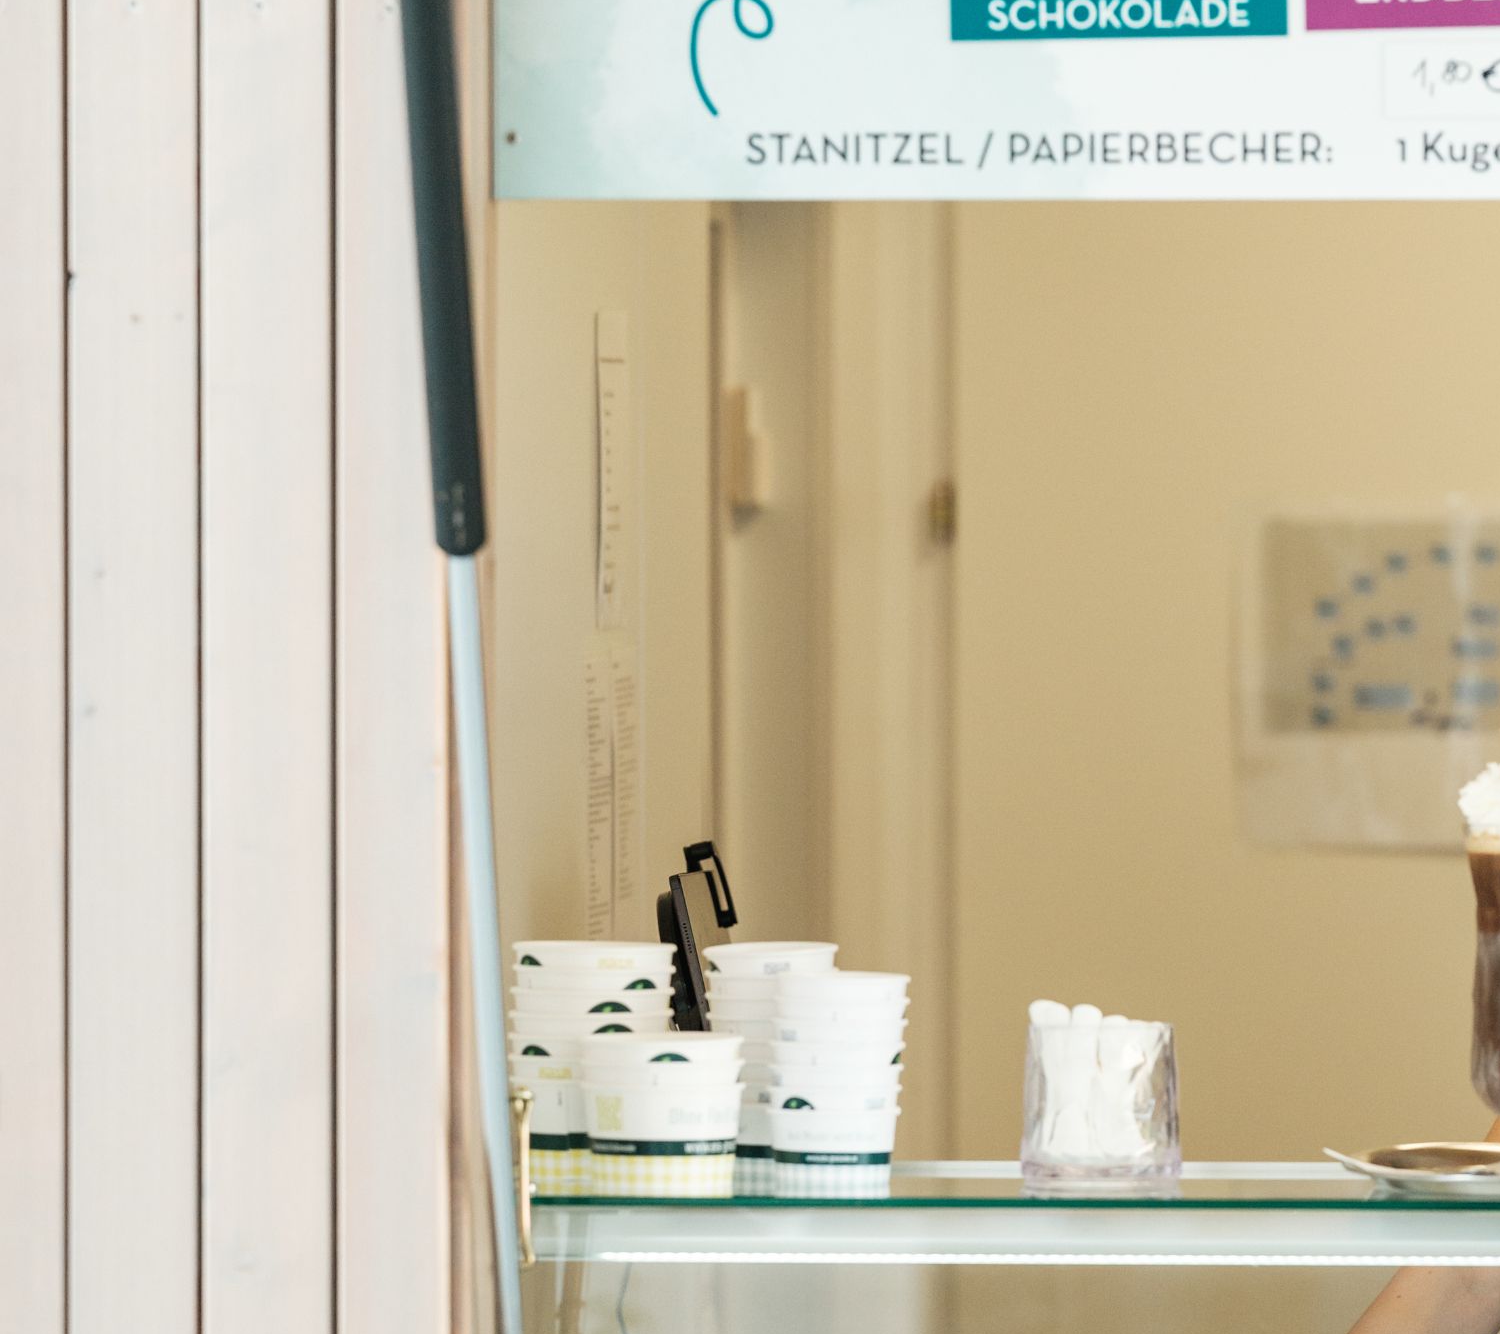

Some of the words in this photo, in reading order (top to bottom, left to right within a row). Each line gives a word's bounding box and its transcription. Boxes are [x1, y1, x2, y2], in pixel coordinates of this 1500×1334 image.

[746, 133, 963, 165] STANITZEL
[1008, 132, 1331, 164] PAPIERBECHER:
[1397, 139, 1406, 162] 1
